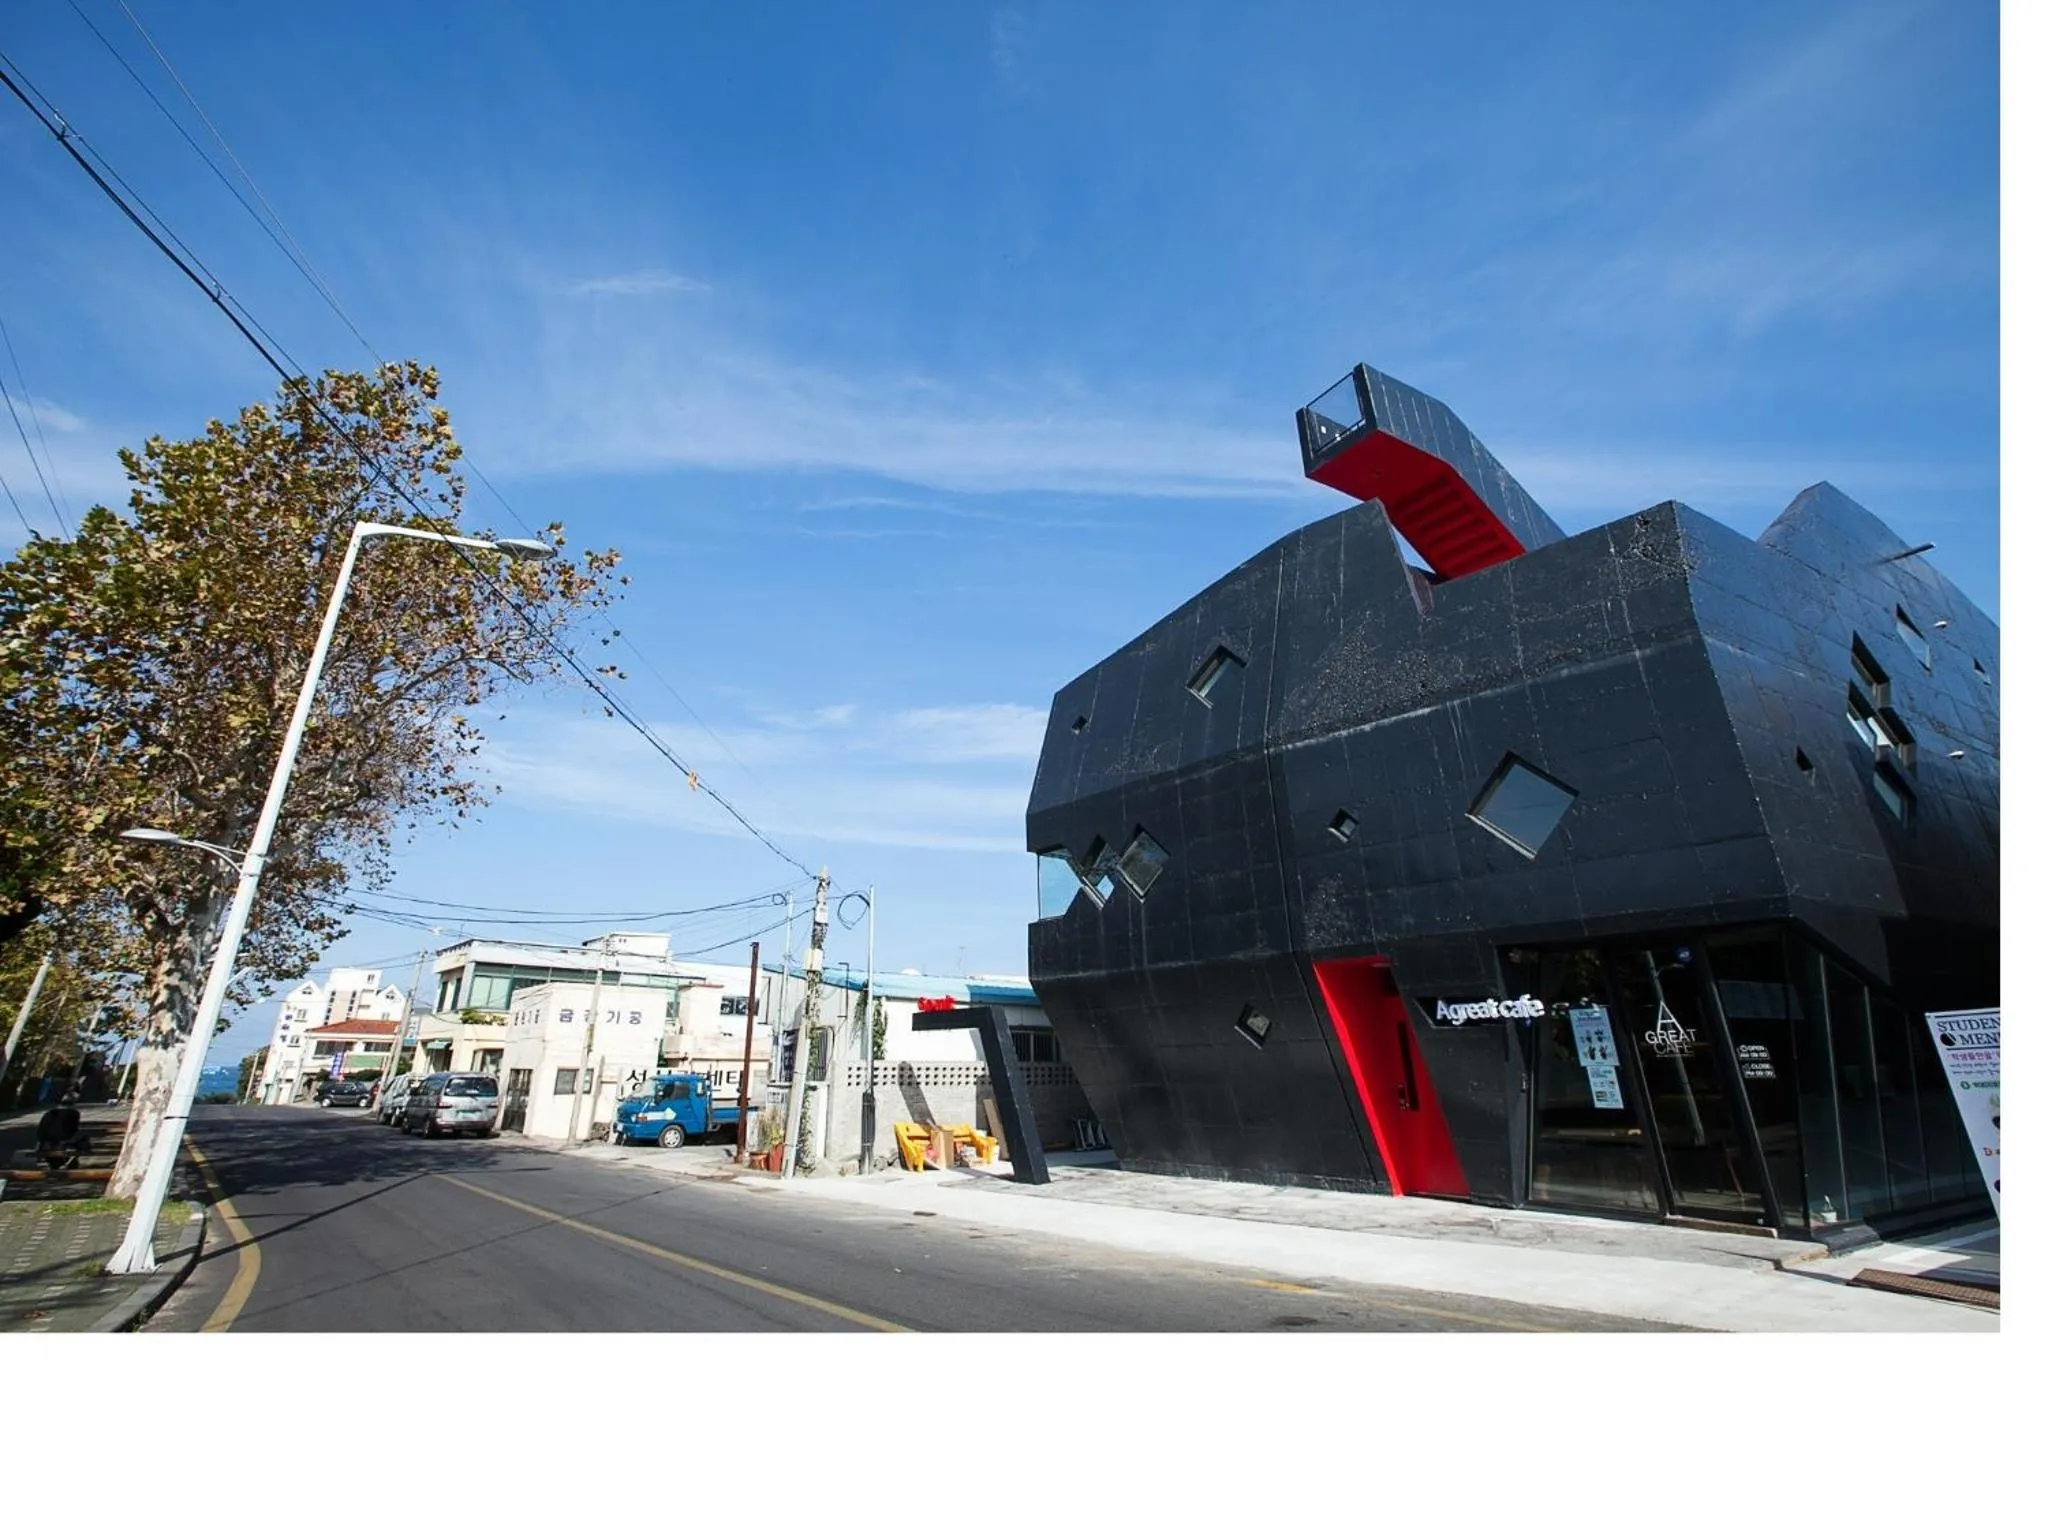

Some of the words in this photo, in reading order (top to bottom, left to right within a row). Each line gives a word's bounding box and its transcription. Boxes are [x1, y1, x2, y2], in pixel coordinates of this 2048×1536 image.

[1645, 1028, 1697, 1044] GREAT
[1959, 1031, 2000, 1046] MEN
[1654, 1041, 1695, 1055] CAFE
